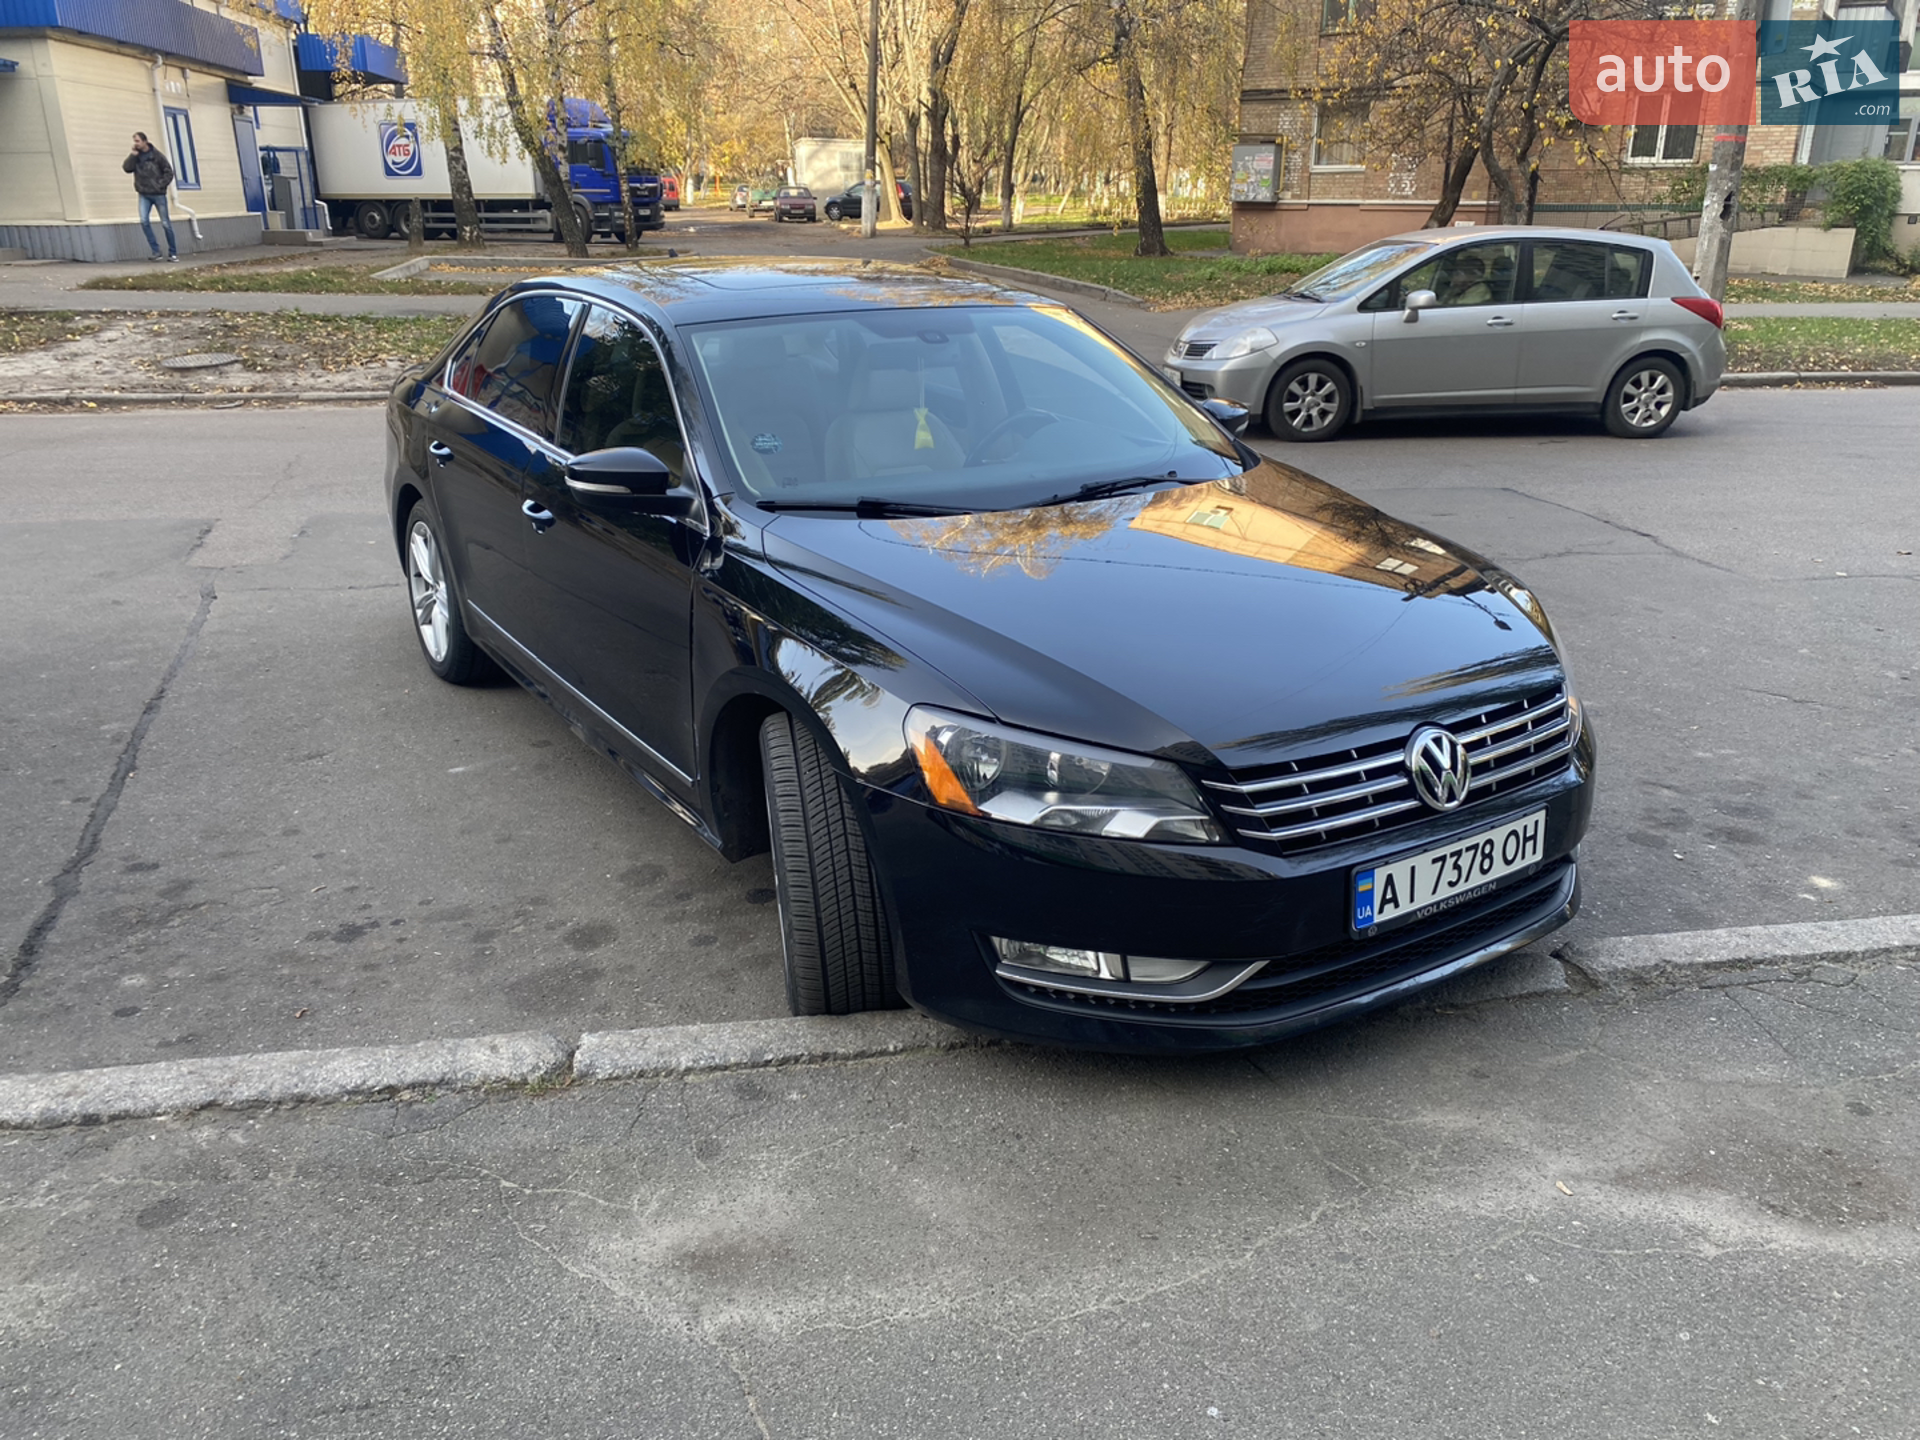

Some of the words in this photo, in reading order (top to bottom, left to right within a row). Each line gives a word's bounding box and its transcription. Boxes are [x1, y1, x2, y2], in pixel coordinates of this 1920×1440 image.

[388, 144, 411, 157] АТБ
[1377, 865, 1416, 915] AI
[1431, 838, 1495, 896] 7378
[1502, 819, 1540, 867] OH
[1357, 905, 1373, 919] UA
[1416, 881, 1497, 919] VOLKSWAGEN
